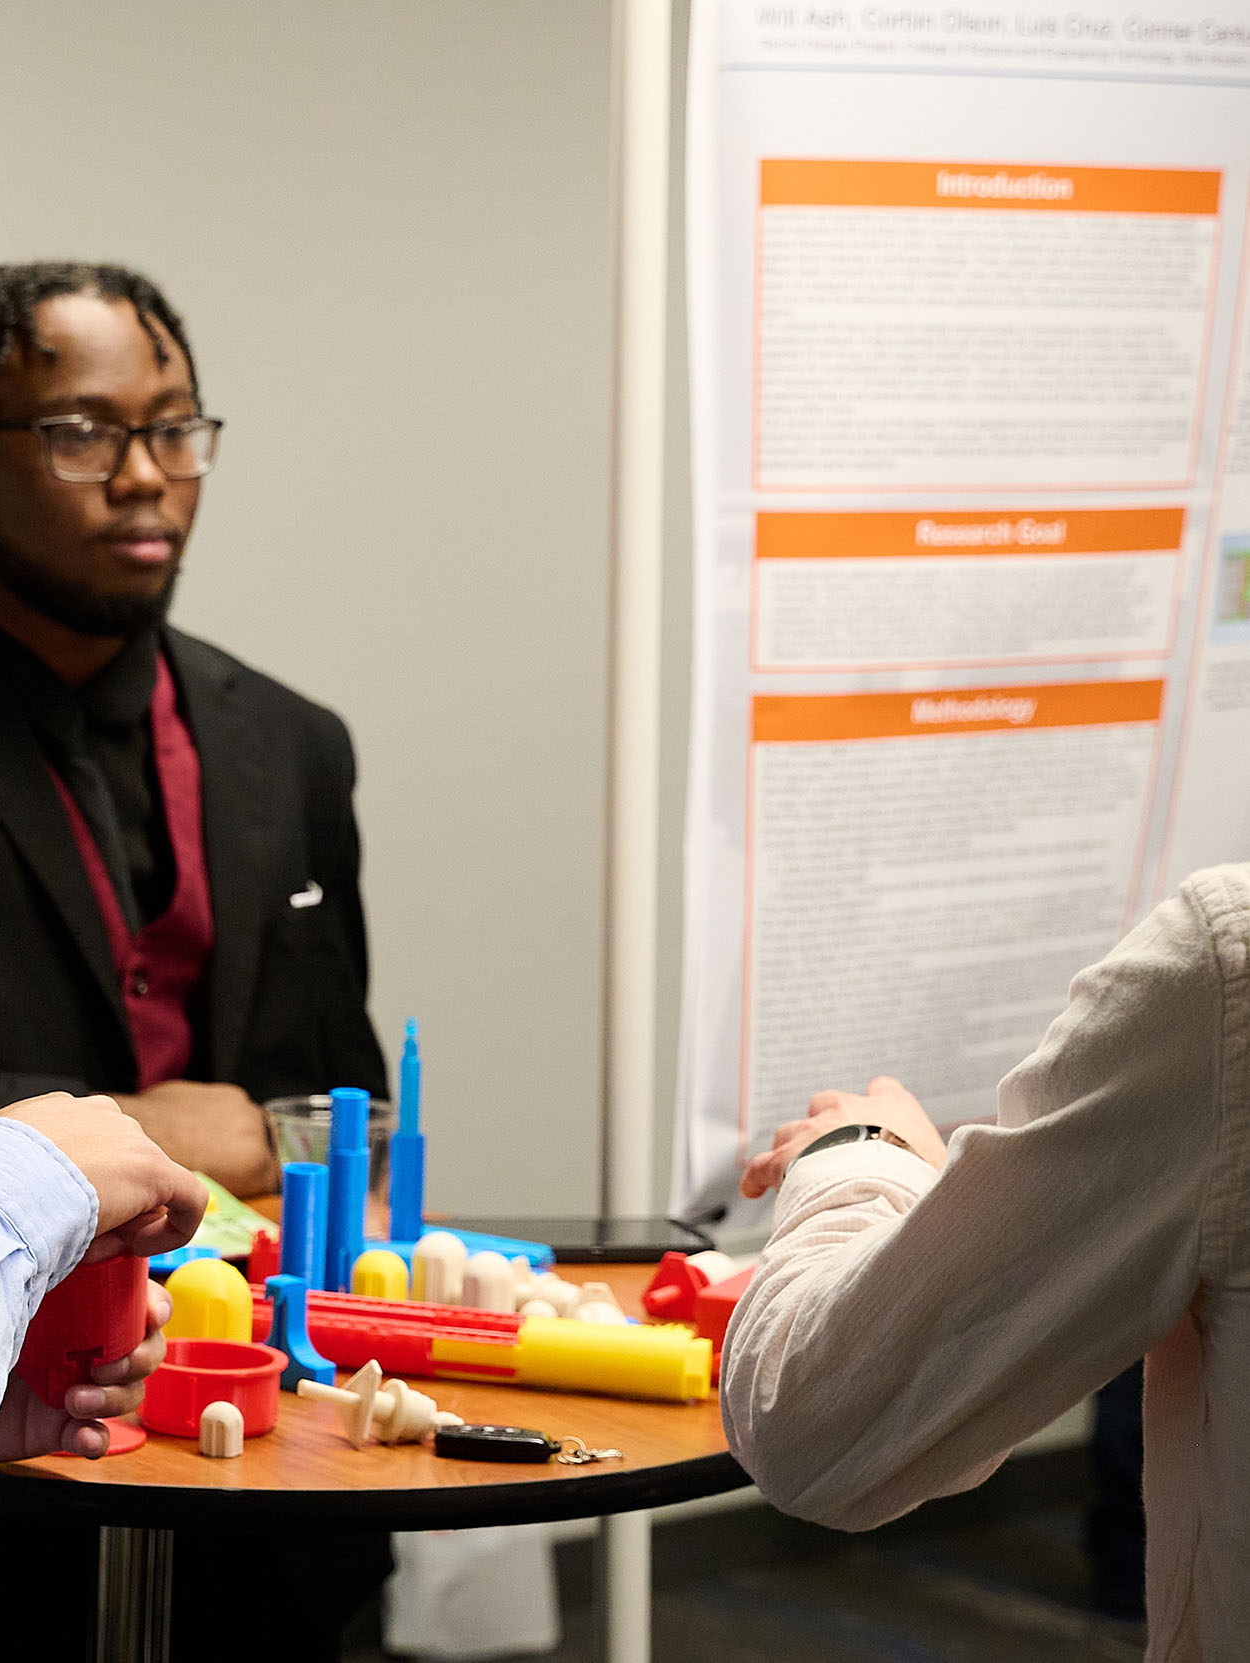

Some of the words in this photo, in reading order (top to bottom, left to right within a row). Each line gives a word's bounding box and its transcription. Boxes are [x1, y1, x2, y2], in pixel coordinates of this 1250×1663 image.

[936, 170, 1074, 200] Introduction
[915, 518, 1014, 547] Research
[1016, 518, 1068, 545] Goal
[910, 695, 1038, 725] Methodology
